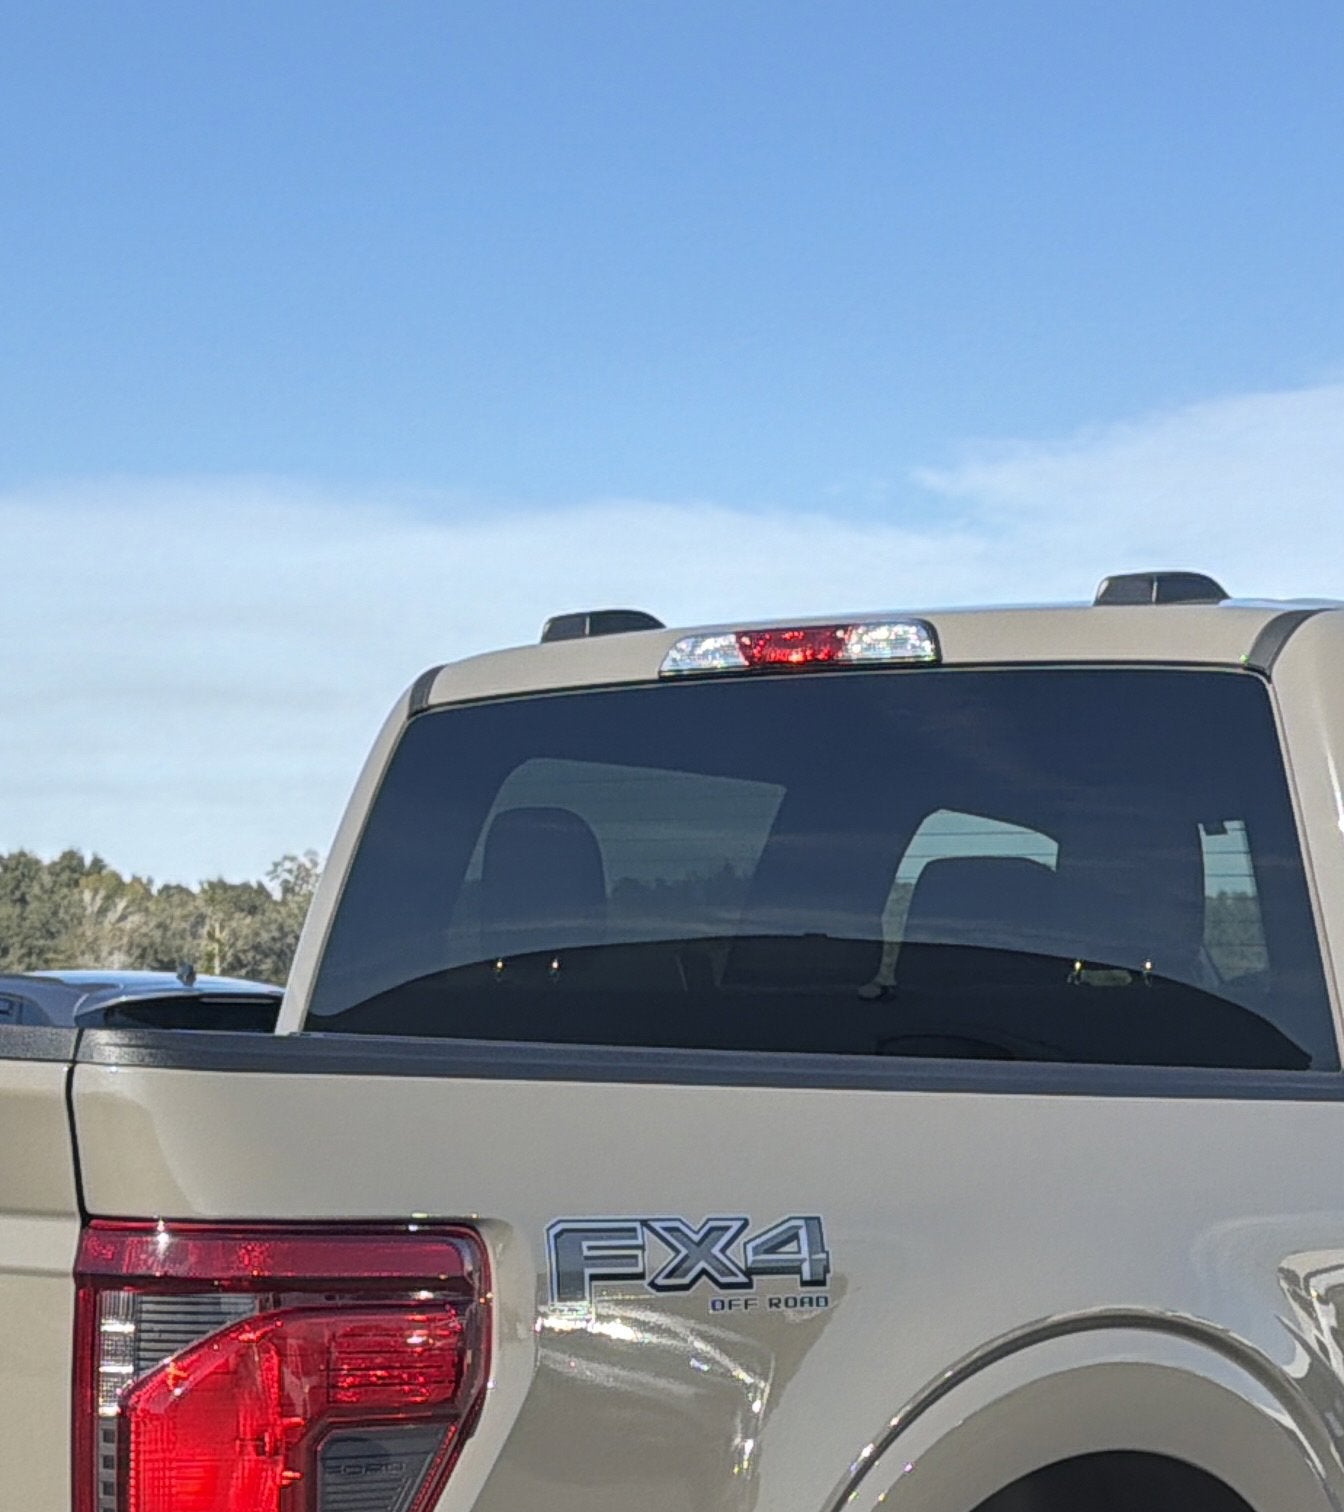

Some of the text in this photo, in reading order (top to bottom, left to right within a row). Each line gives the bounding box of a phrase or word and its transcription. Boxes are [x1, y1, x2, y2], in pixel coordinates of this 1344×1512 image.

[545, 1215, 830, 1316] FX4
[710, 1295, 829, 1312] OFF ROAD
